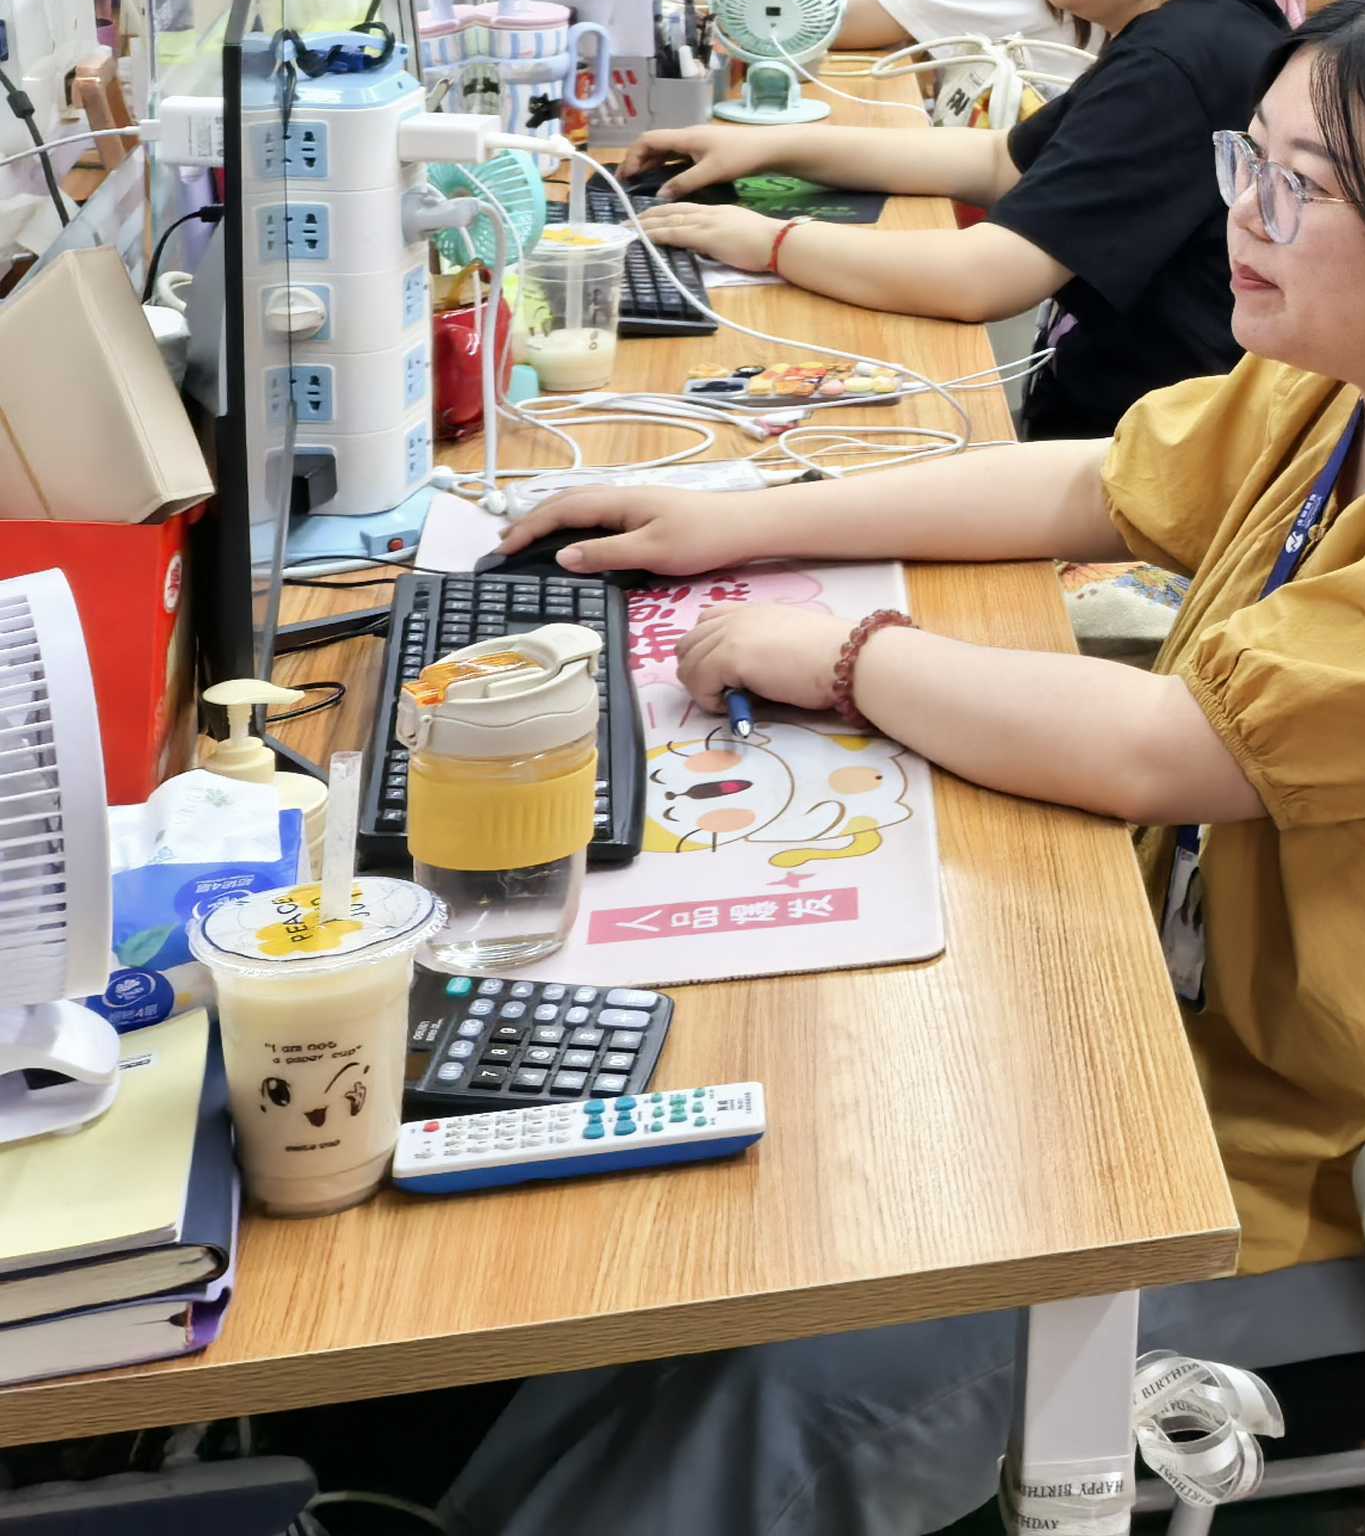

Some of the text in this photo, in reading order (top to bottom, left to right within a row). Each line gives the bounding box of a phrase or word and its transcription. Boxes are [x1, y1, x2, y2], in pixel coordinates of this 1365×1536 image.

[271, 894, 314, 943] PEACE
[615, 893, 836, 934] 人品爆发
[1077, 1478, 1124, 1497] HAPPY
